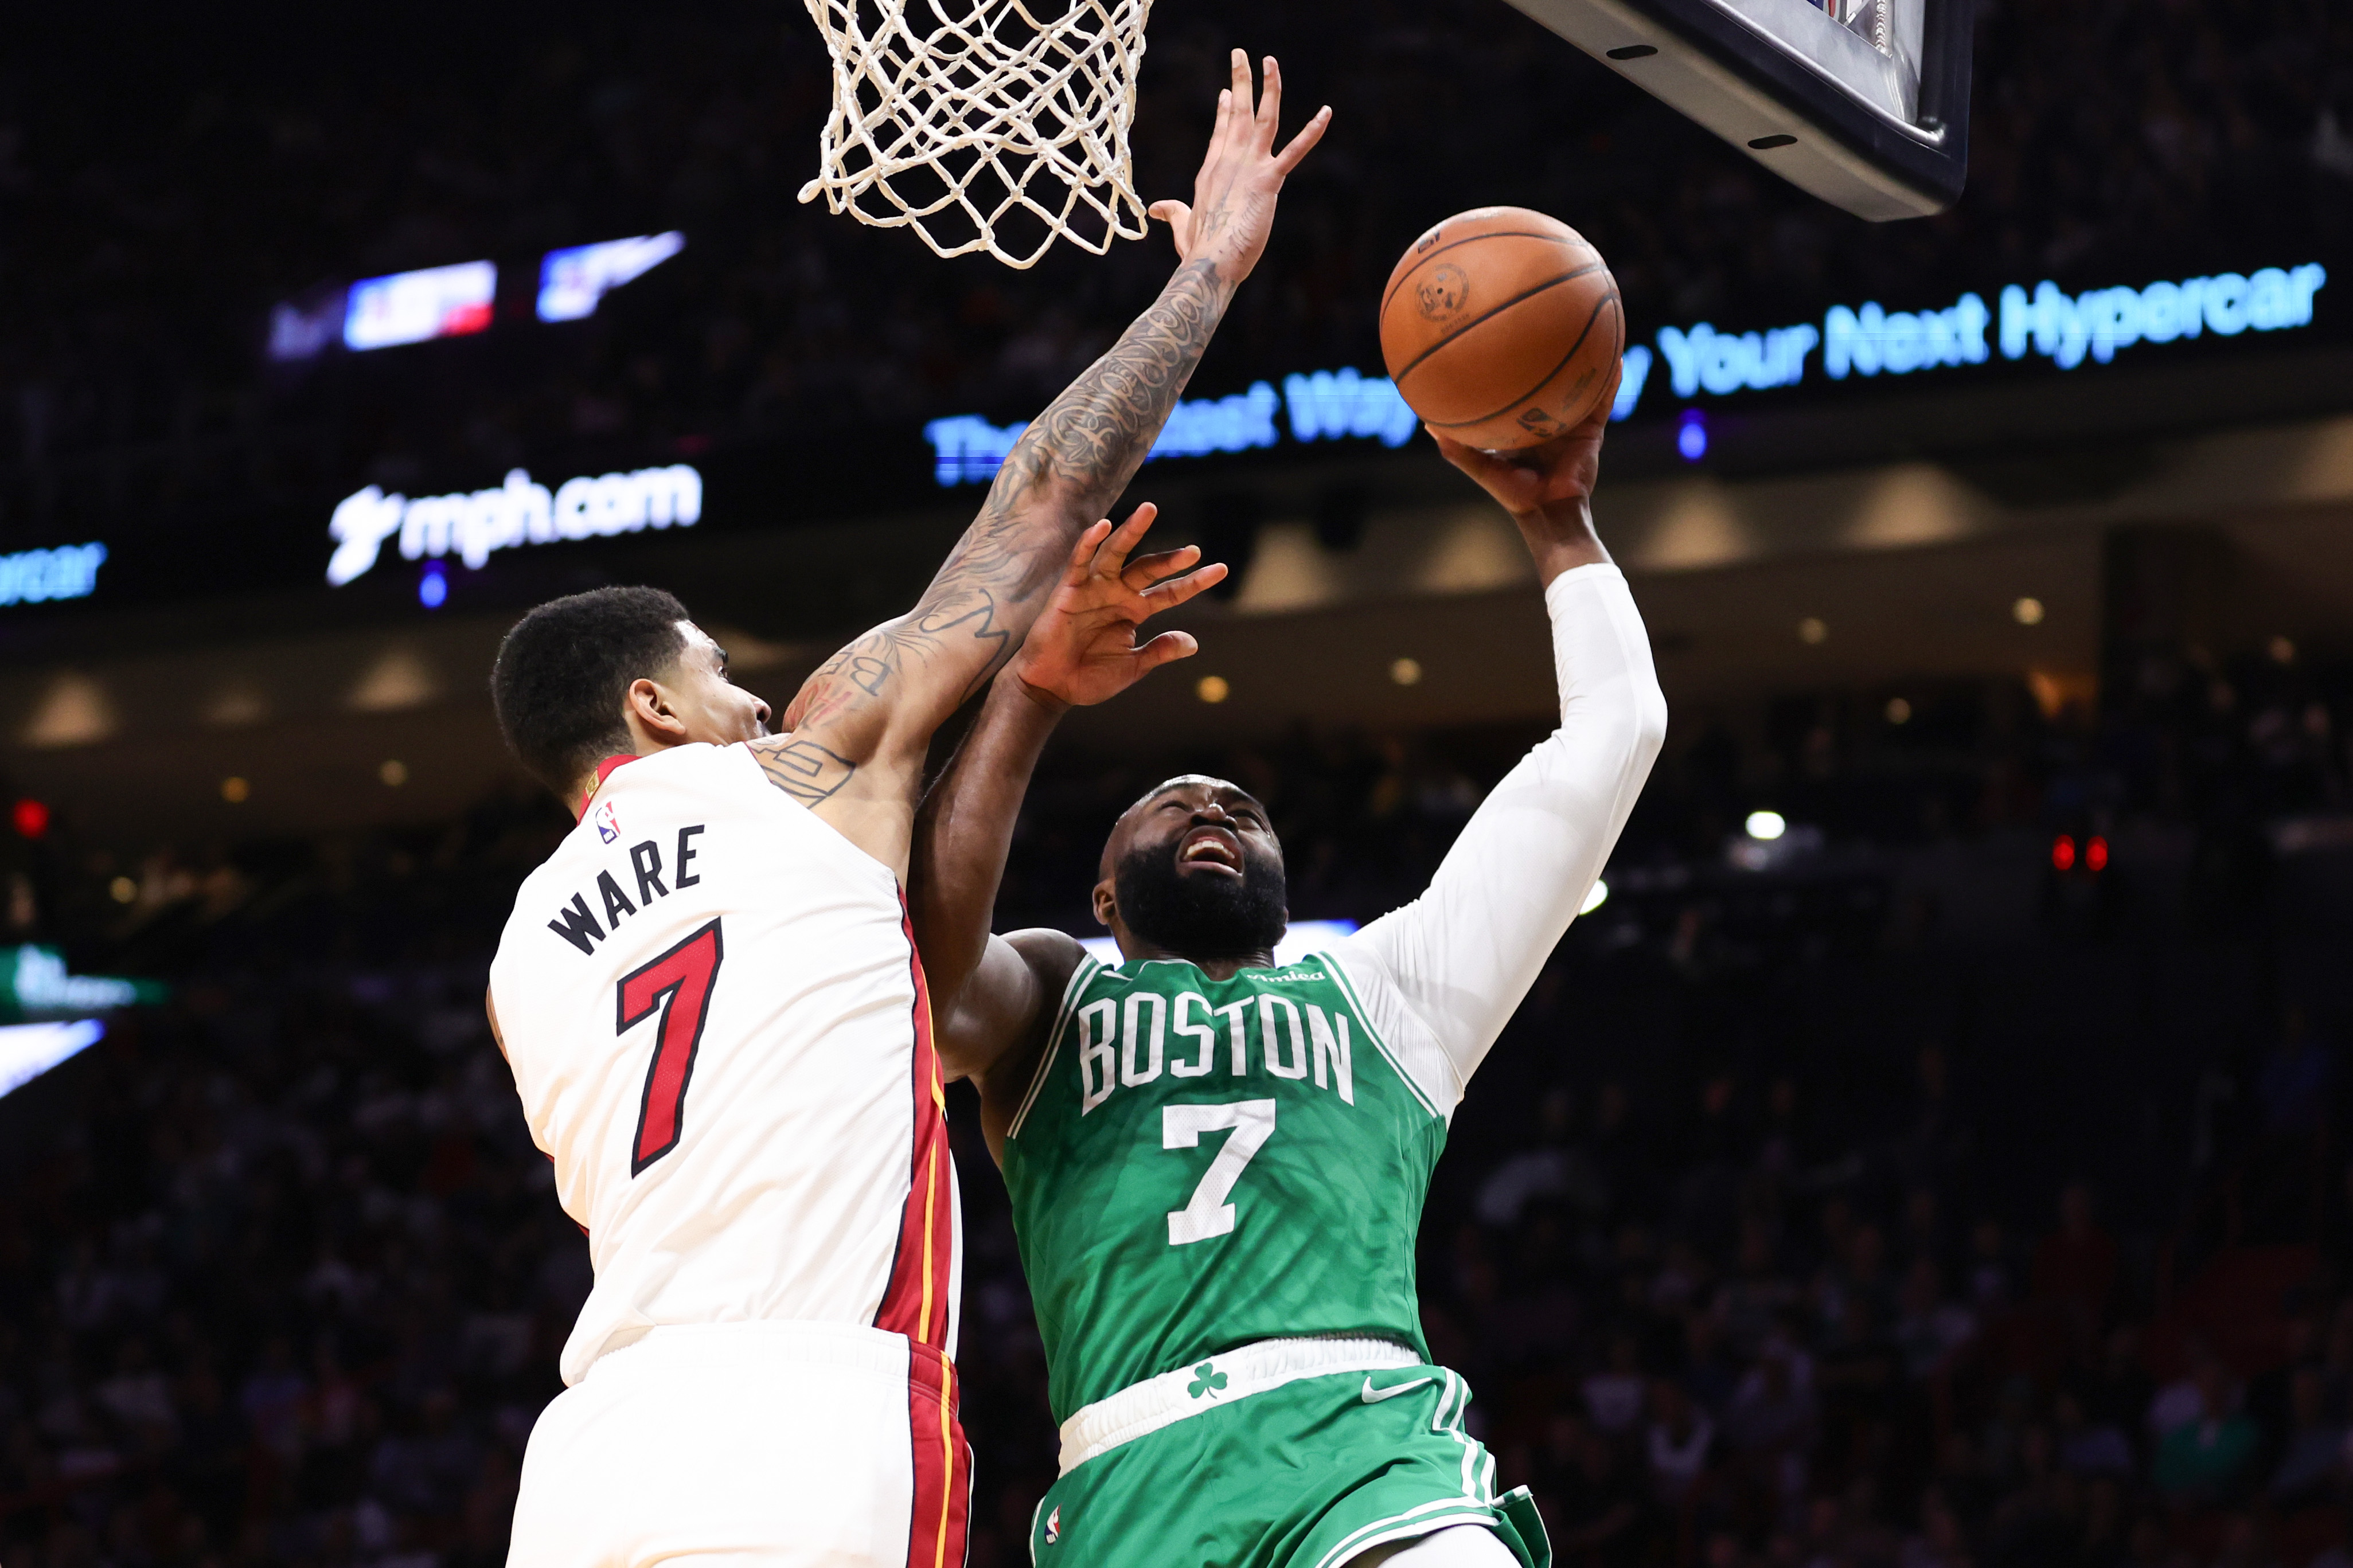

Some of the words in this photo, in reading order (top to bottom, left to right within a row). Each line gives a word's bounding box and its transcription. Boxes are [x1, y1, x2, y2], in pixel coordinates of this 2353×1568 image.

[1656, 322, 1819, 397] Your
[1824, 292, 1991, 378] Next
[1999, 263, 2325, 369] Hypercar
[400, 464, 702, 569] mph.com
[548, 824, 704, 956] WARE
[616, 915, 724, 1179] 7
[1078, 991, 1354, 1117] BOSTON
[1162, 1098, 1276, 1246] 7
